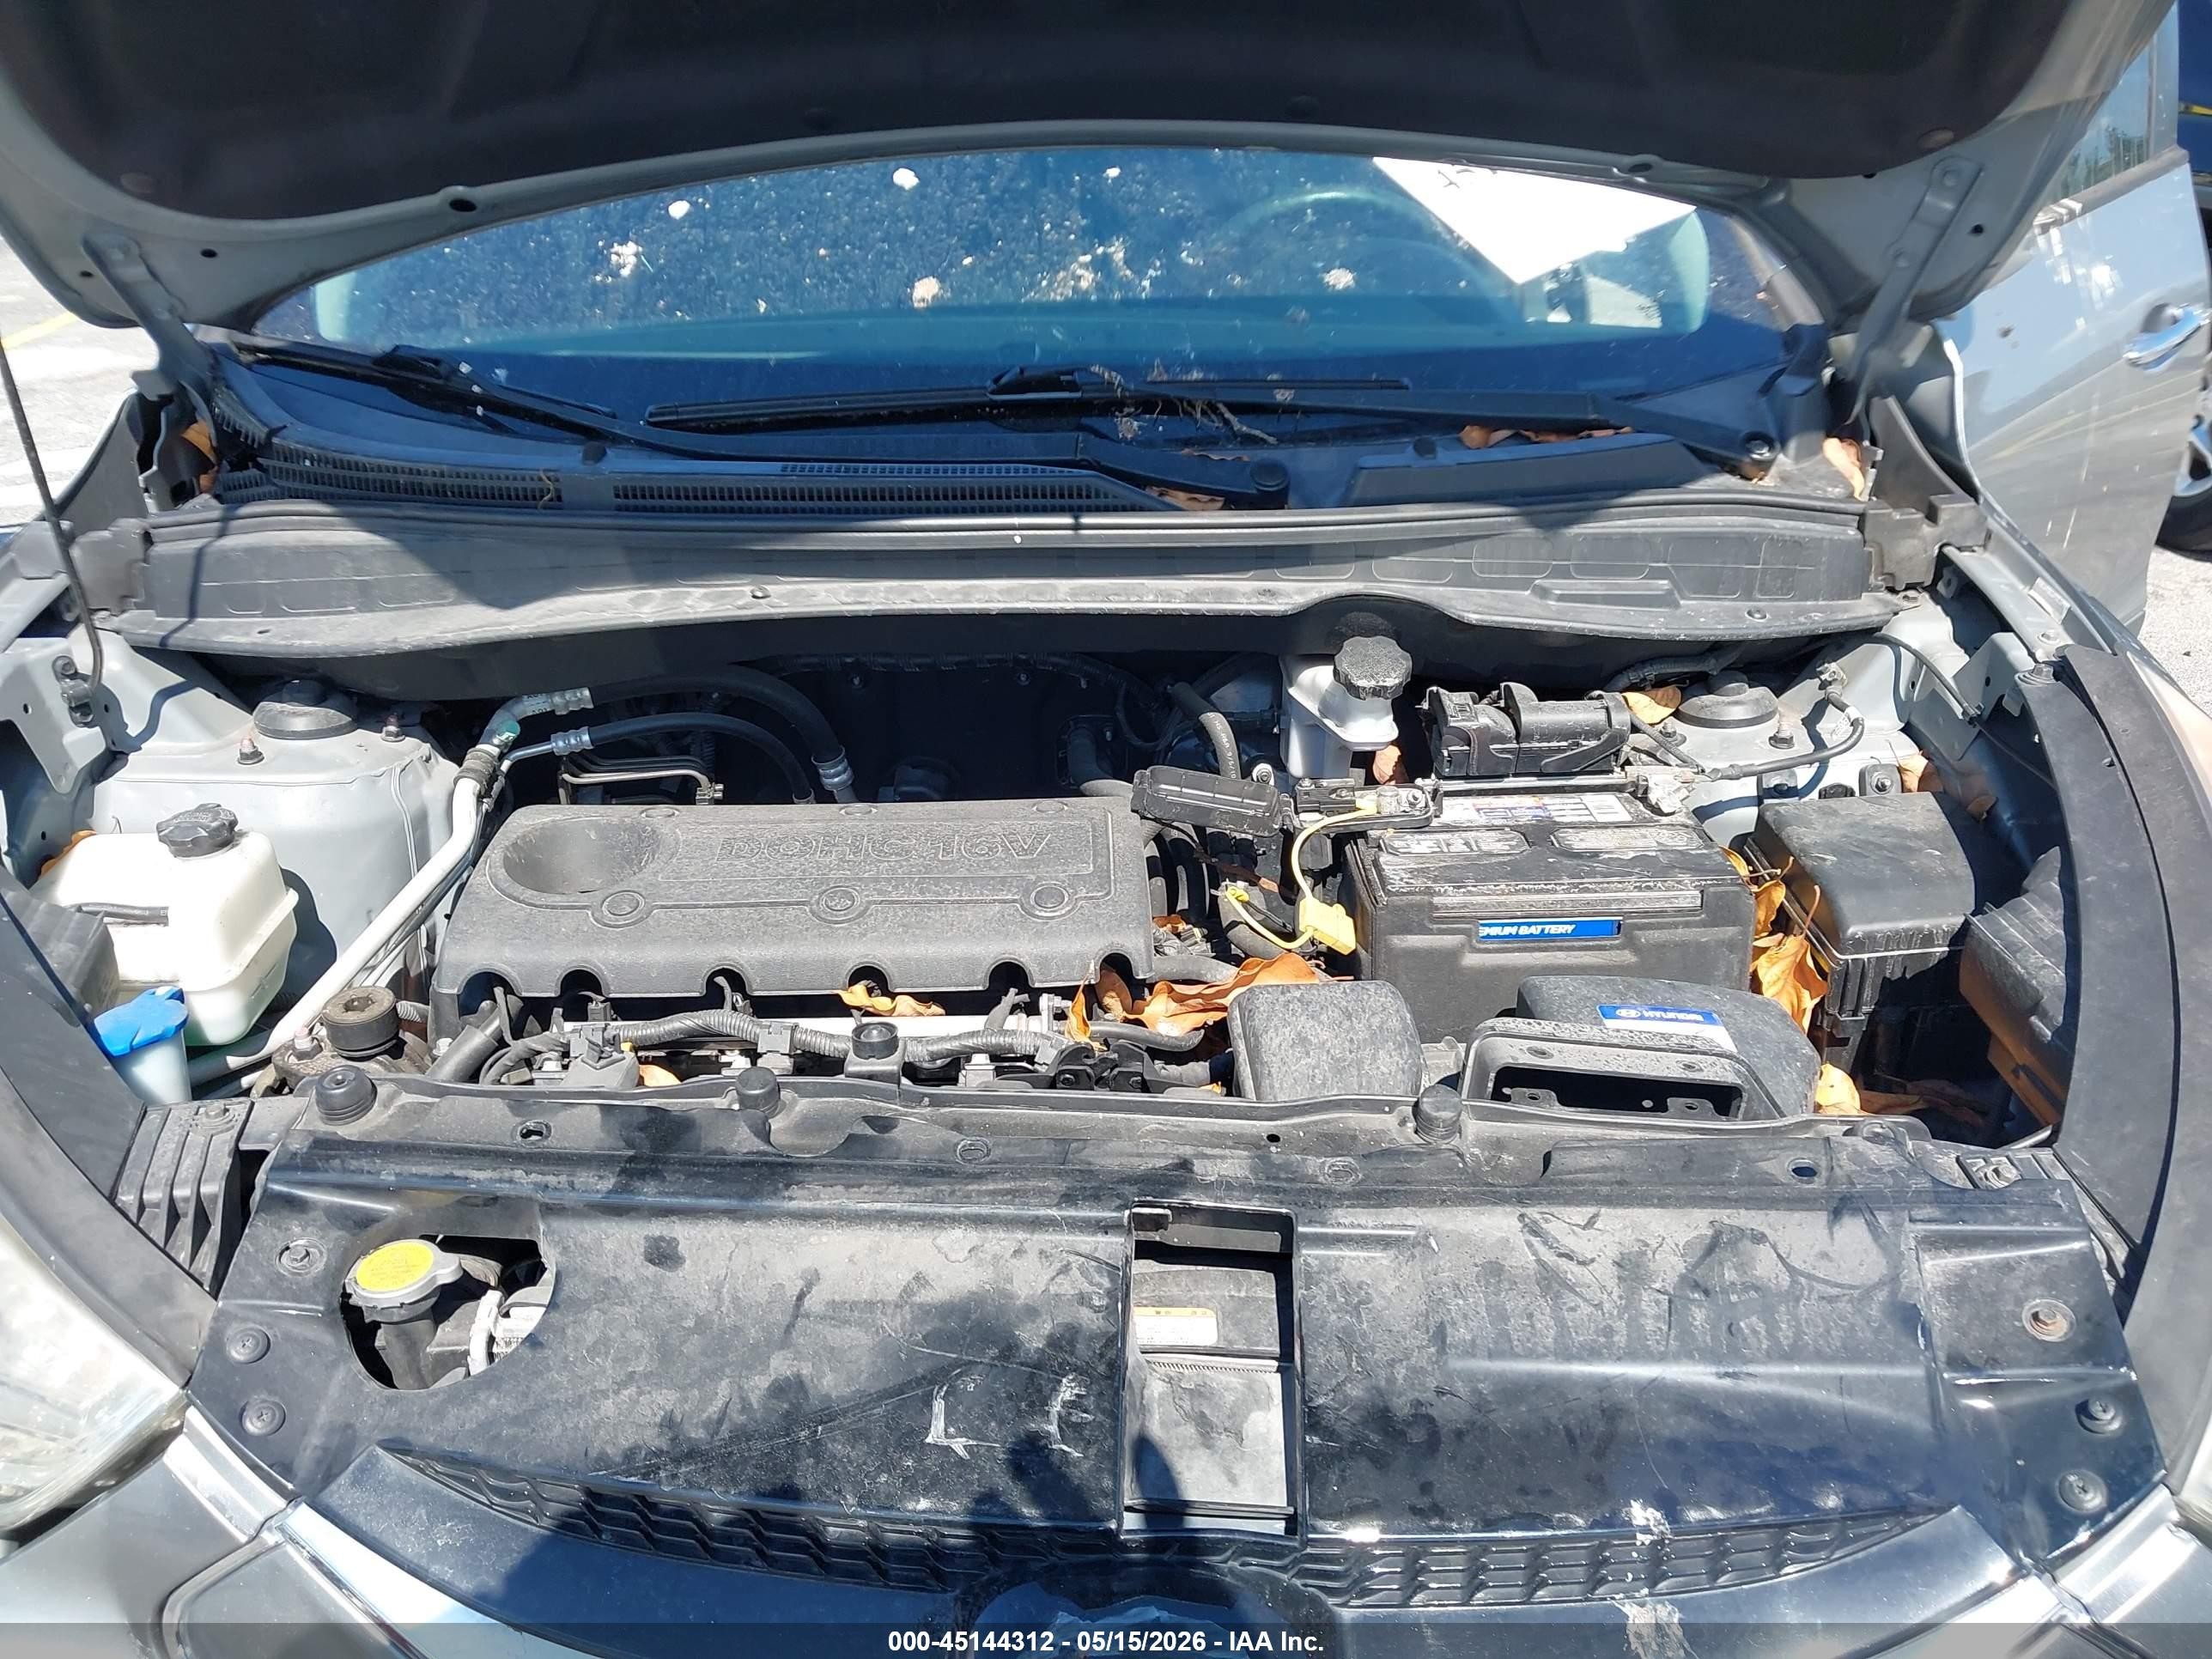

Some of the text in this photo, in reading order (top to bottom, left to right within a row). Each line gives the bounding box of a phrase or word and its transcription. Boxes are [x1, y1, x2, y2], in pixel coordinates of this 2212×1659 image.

[715, 833, 1051, 862] DOHC 16V
[1518, 924, 1577, 936] BATTERY
[1643, 1010, 1705, 1022] HYUNDAI
